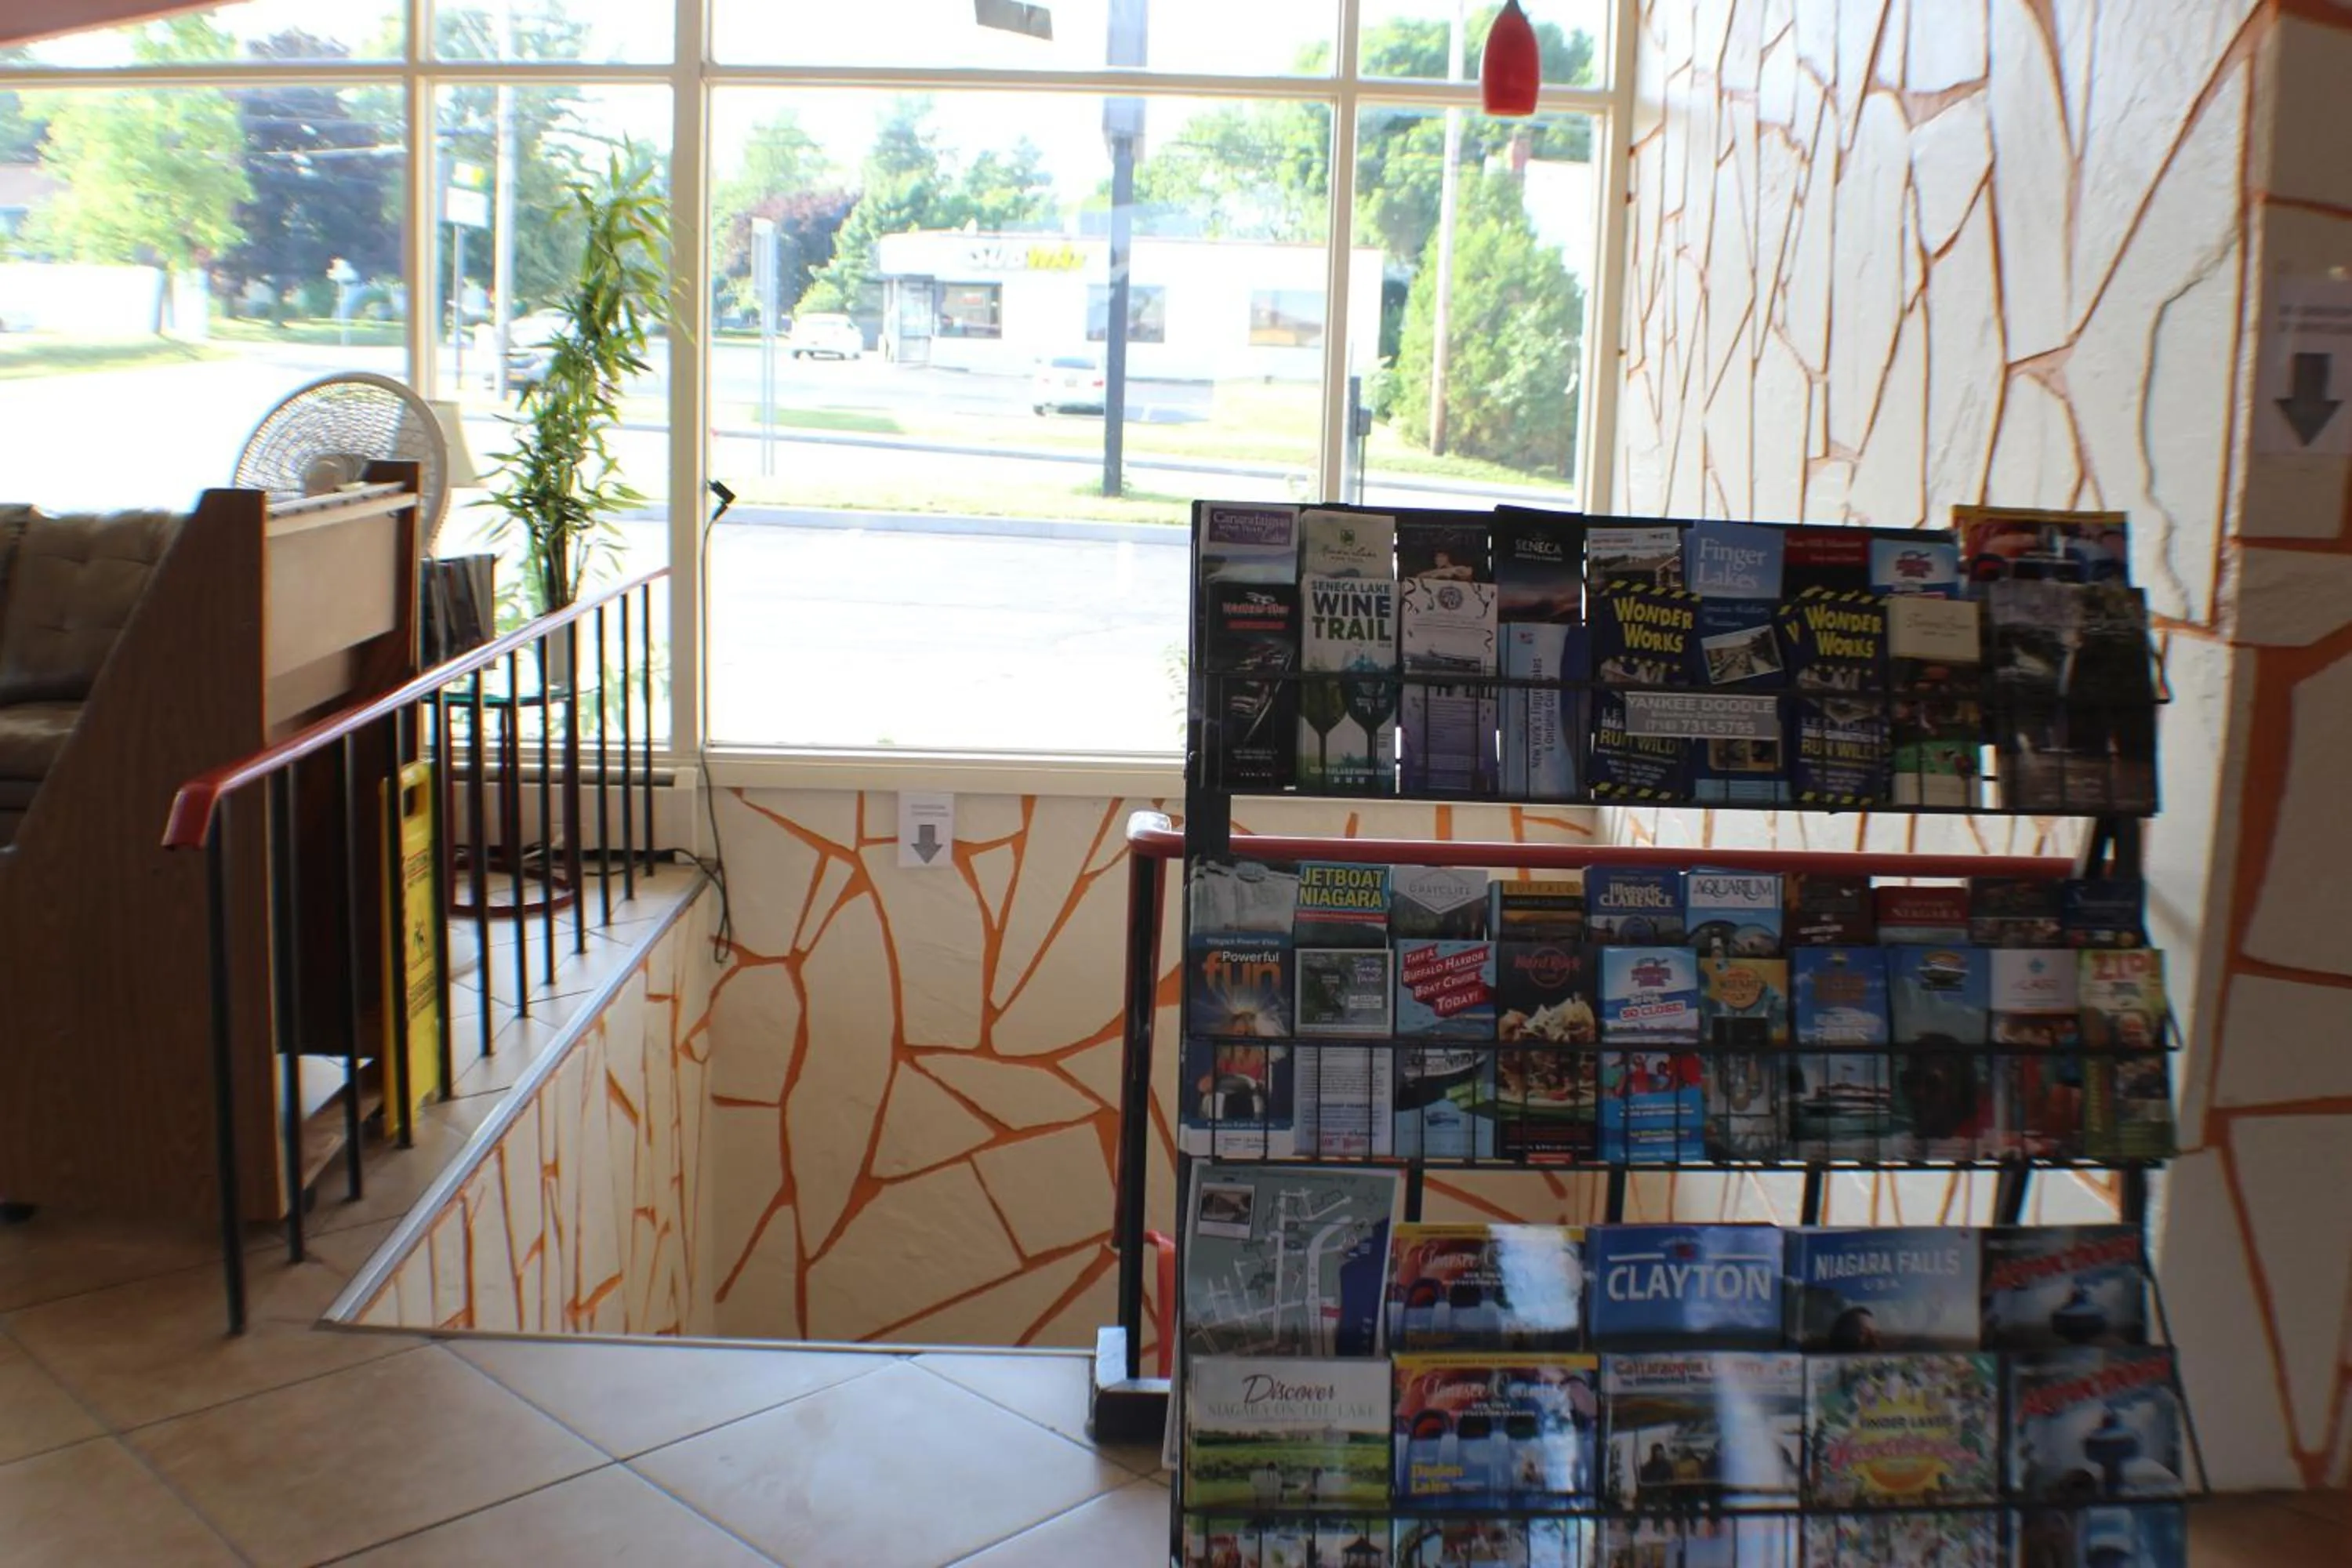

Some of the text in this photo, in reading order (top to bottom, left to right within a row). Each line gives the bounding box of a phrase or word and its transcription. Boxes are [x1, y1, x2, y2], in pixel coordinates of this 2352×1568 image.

[1700, 537, 1768, 572] Finger
[1312, 580, 1391, 594] SENECA LAKE
[1697, 561, 1759, 590] Lakes
[1313, 591, 1391, 618] WINE
[1613, 597, 1693, 629] WONDER
[1312, 616, 1392, 641] TRAIL
[1805, 603, 1882, 634] WONDER
[1623, 622, 1685, 653] WORKS
[1815, 630, 1875, 659] WORKS
[1626, 695, 1776, 713] YANKEE DOODLE
[1637, 736, 1677, 755] WILD
[1300, 867, 1385, 888] JETBOAT
[1693, 878, 1773, 901] AQUARIUM
[1299, 887, 1383, 908] NIAGARA
[1599, 894, 1675, 908] CLARENCE
[1221, 951, 1279, 963] Powerful
[1403, 963, 1443, 982] BUFFALO
[1445, 951, 1485, 971] HARBOR
[1203, 951, 1281, 993] fun
[1414, 982, 1440, 997] BOAT
[1436, 991, 1480, 1012] TODAY!
[1814, 1252, 1893, 1280] NIAGARA
[1896, 1248, 1960, 1276] FALLS
[1608, 1264, 1771, 1301] CLAYTON
[1242, 1374, 1336, 1404] Discover
